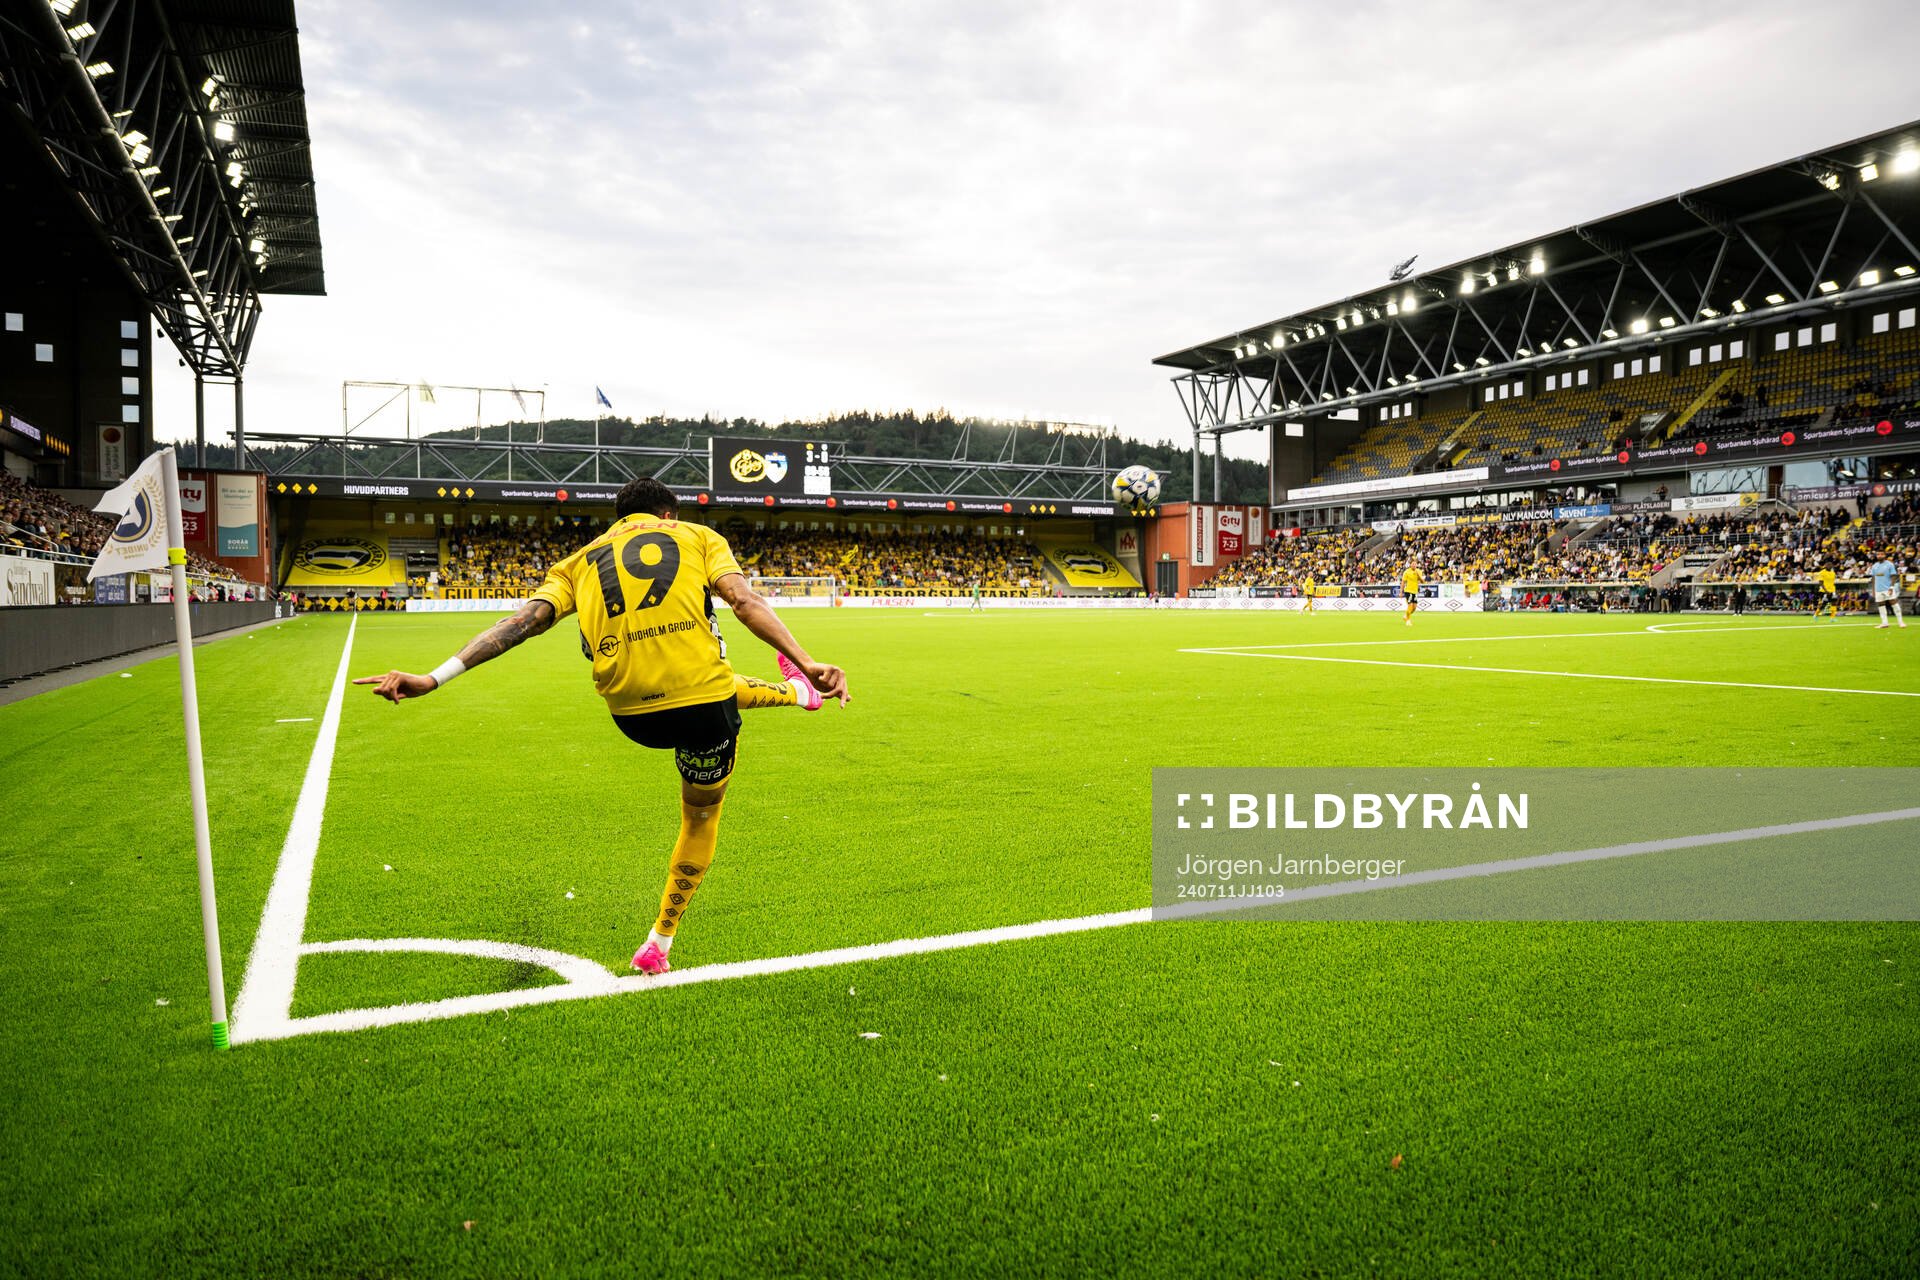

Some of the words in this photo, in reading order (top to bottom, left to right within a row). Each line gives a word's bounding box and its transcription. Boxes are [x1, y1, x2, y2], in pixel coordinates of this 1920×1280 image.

[1803, 429, 1843, 443] Sparbanken
[1844, 424, 1875, 439] Sjuhärad
[1717, 438, 1751, 450] Sparbanken
[1752, 435, 1780, 448] Sjuhärad
[1568, 457, 1595, 467] Sparbanken
[1596, 454, 1617, 465] Sjuhärad
[1638, 450, 1668, 461] Sparbanken
[1669, 446, 1694, 458] Sjuhärad
[1505, 464, 1530, 474] Sparbanken
[1531, 462, 1549, 472] Sjuhärad
[344, 485, 409, 495] HUVUDPARTNERS
[501, 490, 532, 498] Sparbanken
[533, 490, 556, 499] Sjuhärad
[576, 492, 605, 500] Sparbanken
[1517, 510, 1552, 520] MAN.COM
[586, 532, 680, 618] 19
[8, 568, 49, 605] Sandwall
[627, 625, 666, 643] RUDHOLM
[668, 621, 696, 633] GROUP
[641, 692, 666, 701] umbro
